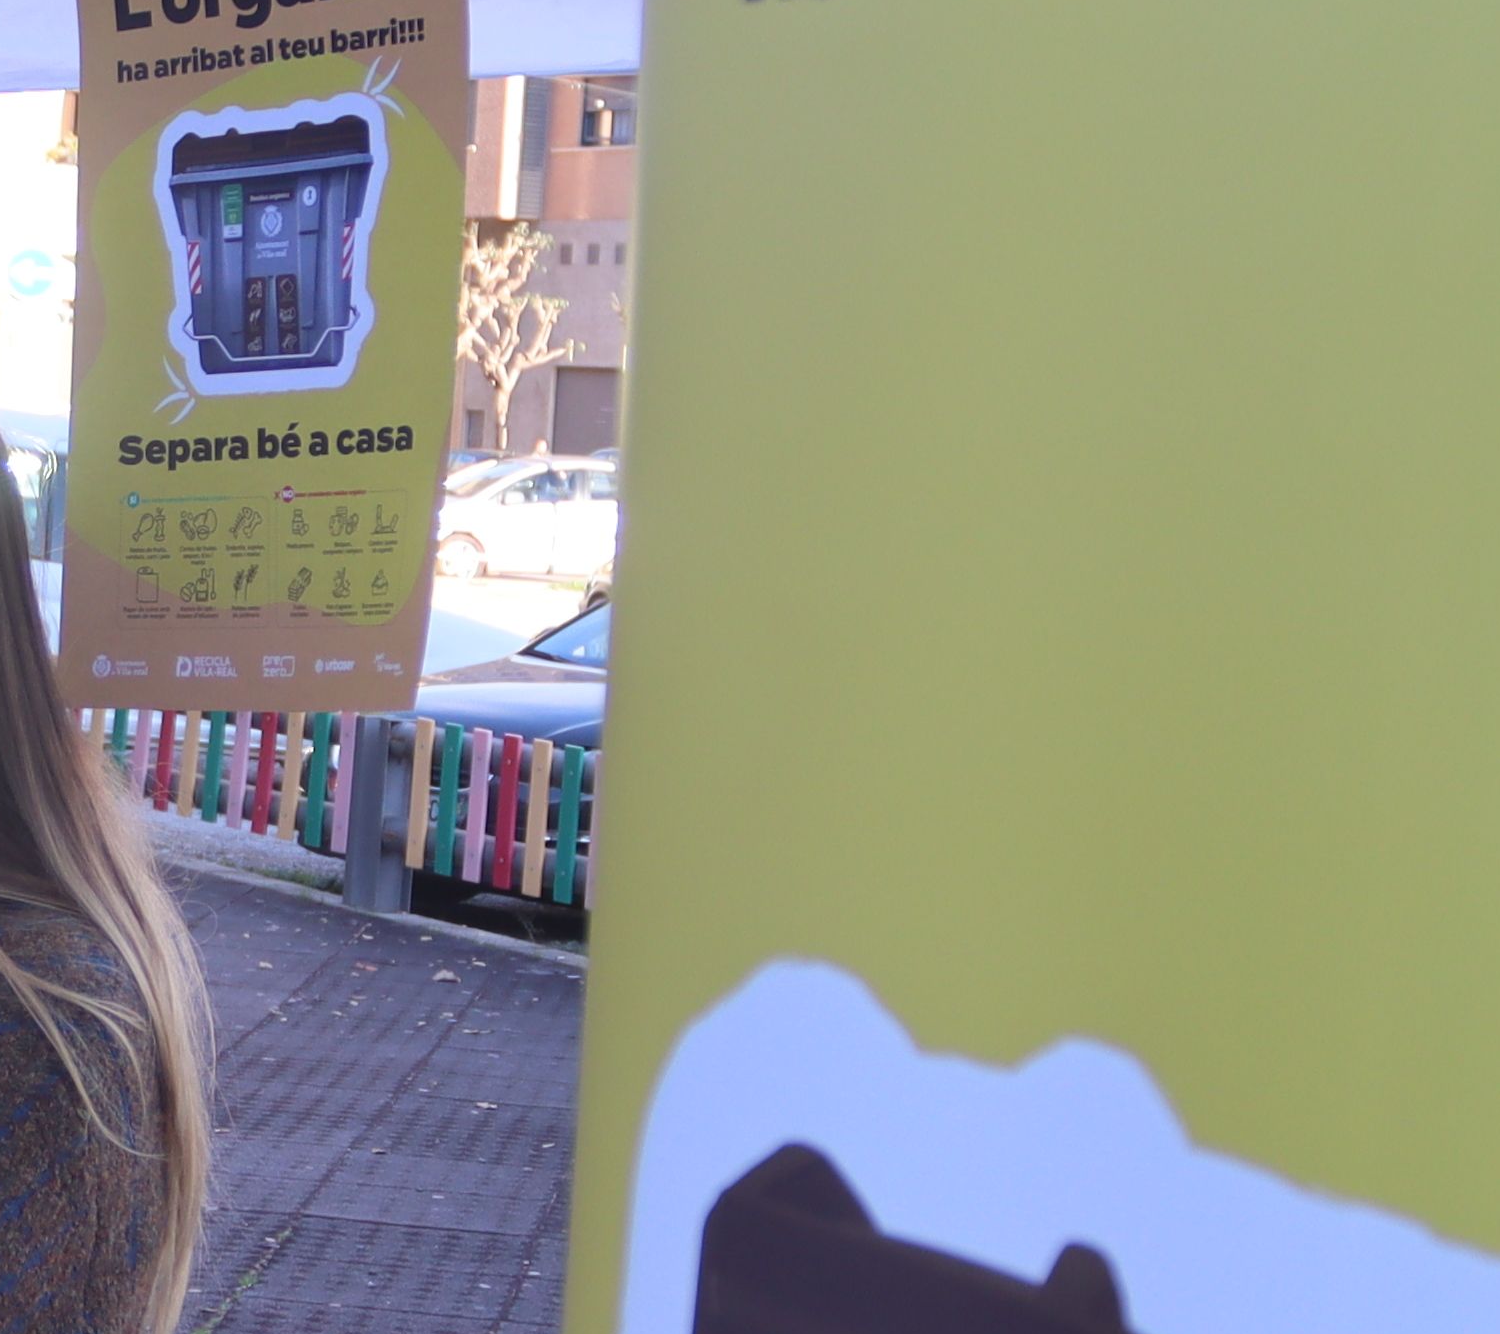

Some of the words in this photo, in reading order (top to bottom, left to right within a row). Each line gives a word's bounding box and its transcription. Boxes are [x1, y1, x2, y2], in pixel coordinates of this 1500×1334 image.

[117, 60, 149, 83] ha
[154, 44, 245, 78] arribat
[250, 39, 274, 64] al
[279, 37, 324, 60] teu
[331, 17, 425, 53] barri!!!
[117, 433, 251, 472] Separa
[256, 422, 301, 459] bé
[308, 434, 330, 458] a
[335, 423, 414, 455] casa
